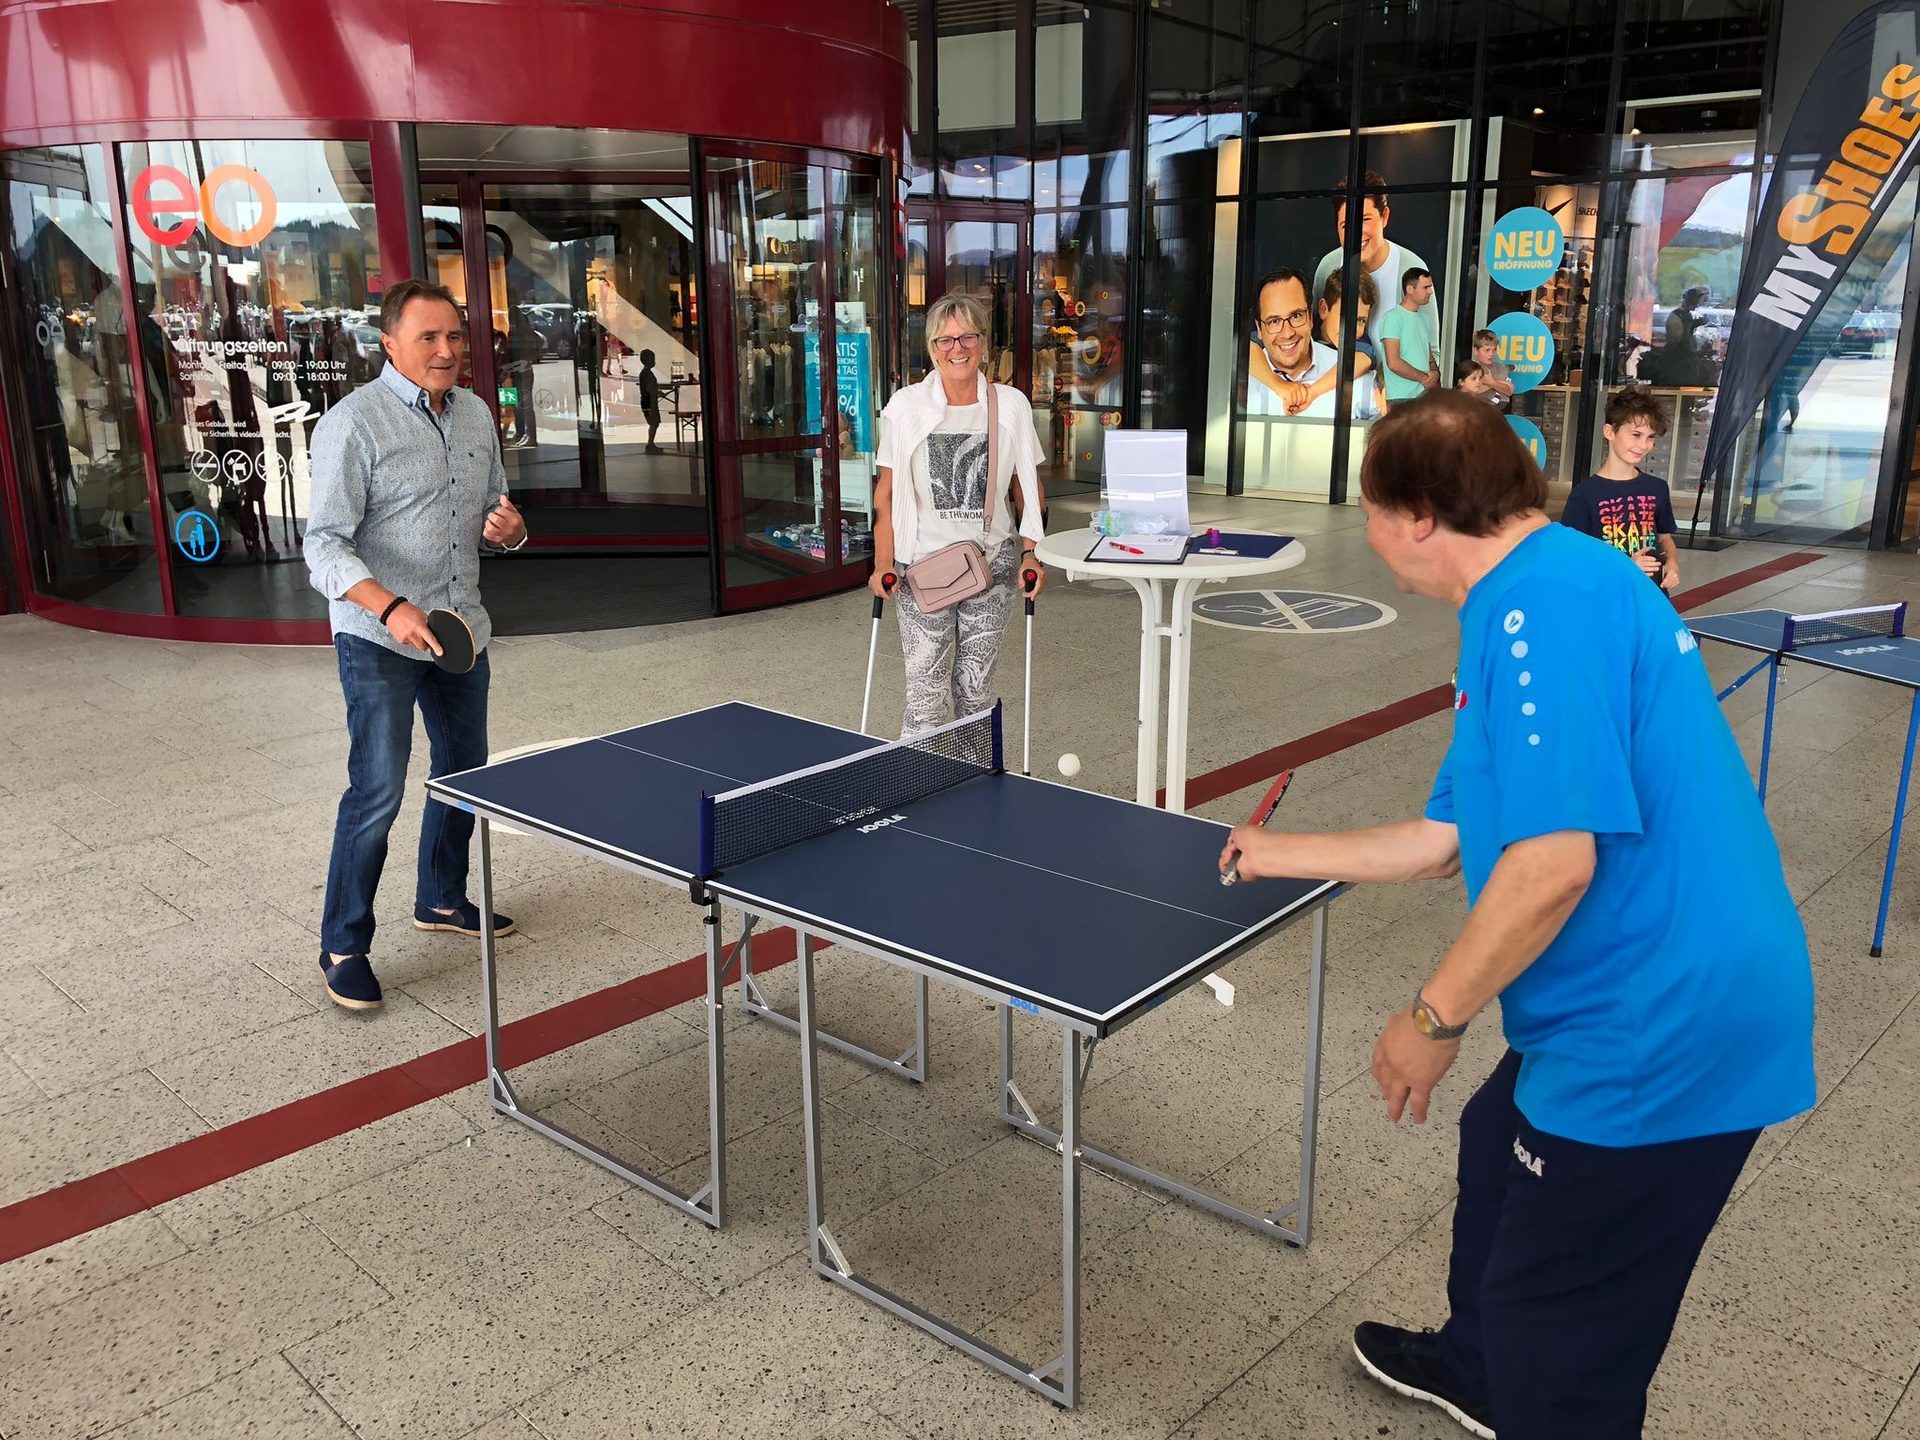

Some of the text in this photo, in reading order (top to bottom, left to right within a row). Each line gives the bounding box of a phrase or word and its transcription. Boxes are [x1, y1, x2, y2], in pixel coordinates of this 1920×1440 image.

[132, 164, 277, 247] eo
[1494, 230, 1556, 258] NEU
[1493, 258, 1553, 270] ERÖFFNUNG
[177, 336, 288, 356] Öffnungszeiten
[178, 360, 210, 371] Monta
[272, 361, 296, 370] 09:00
[305, 361, 329, 370] 19:00
[331, 361, 347, 370] Uhr
[842, 366, 857, 375] TAG
[272, 372, 297, 381] 09:00
[307, 372, 330, 381] 18:00
[331, 372, 348, 381] Uhr
[939, 511, 948, 519] BE
[961, 511, 983, 519] WOM
[1602, 521, 1655, 538] SKATE
[856, 814, 908, 833] JOOLA
